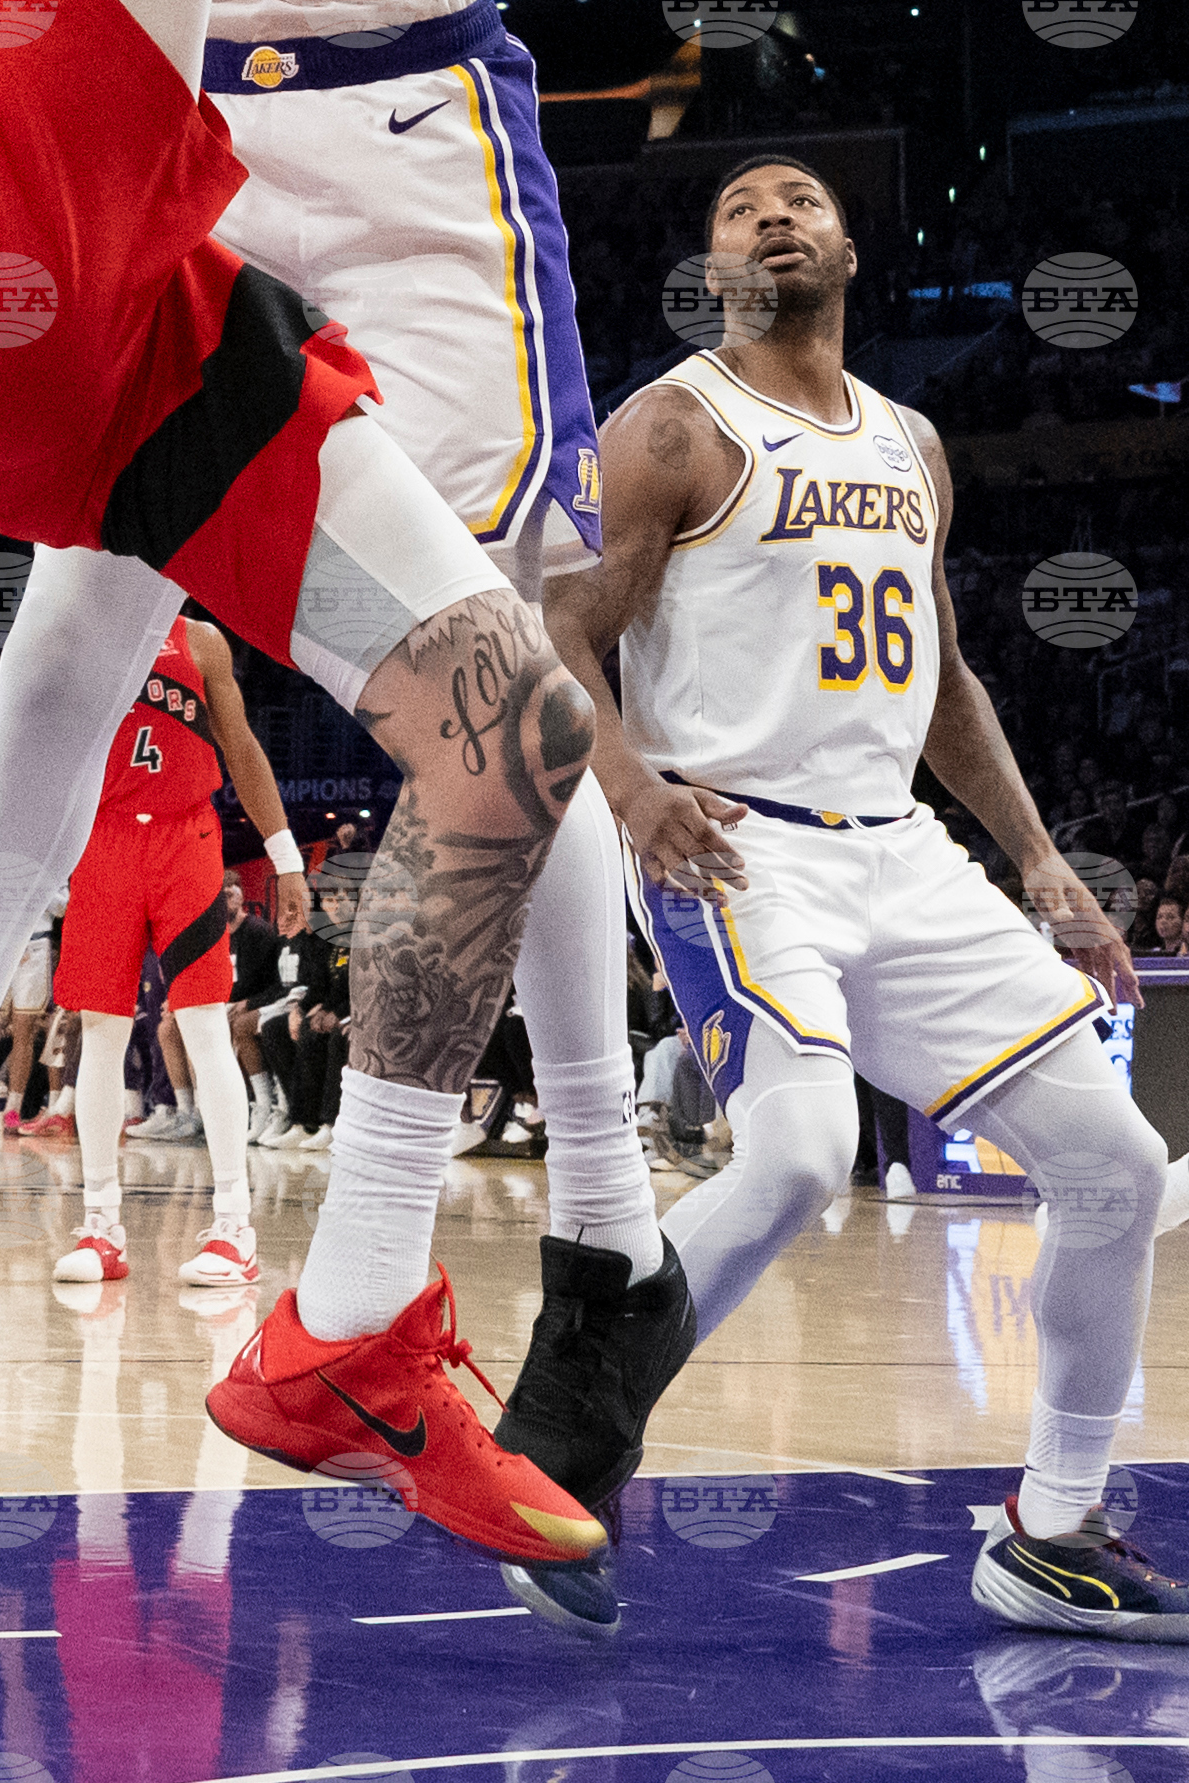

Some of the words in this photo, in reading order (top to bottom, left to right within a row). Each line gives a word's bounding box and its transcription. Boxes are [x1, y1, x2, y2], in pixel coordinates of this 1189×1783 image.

[758, 467, 929, 547] LAKERS
[816, 560, 915, 695] 36
[132, 726, 163, 774] 4
[224, 777, 373, 804] CMPIONS
